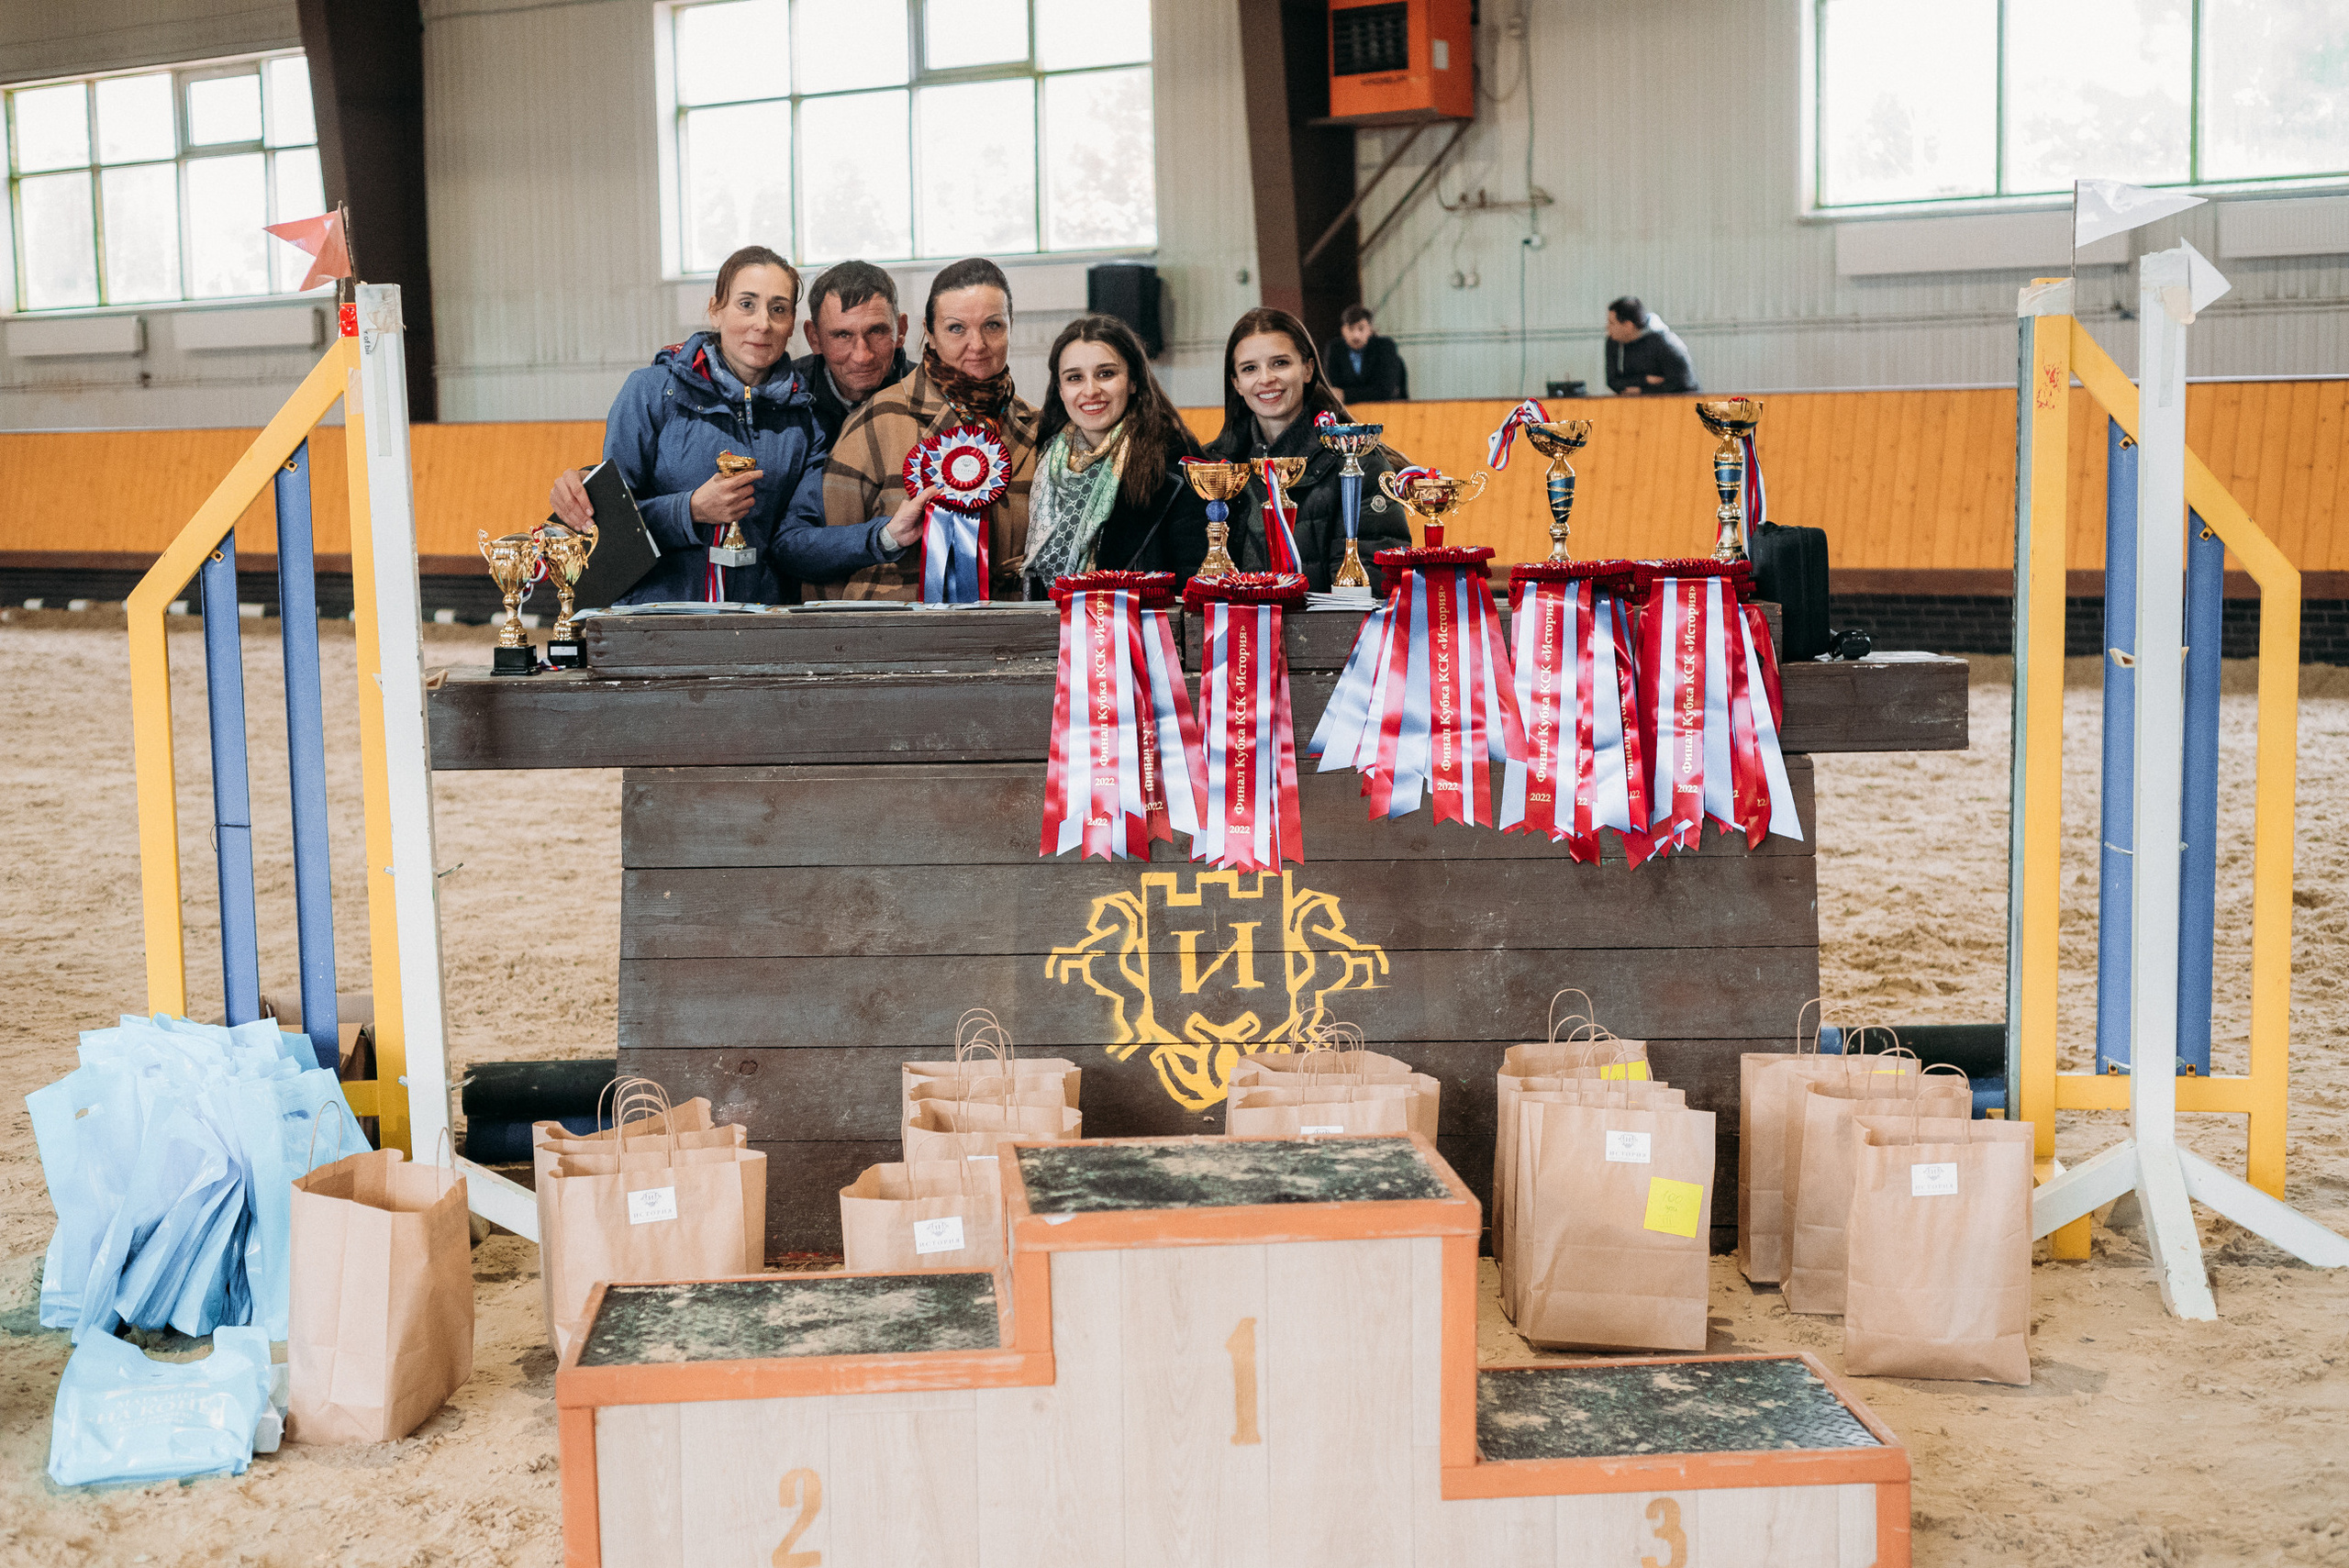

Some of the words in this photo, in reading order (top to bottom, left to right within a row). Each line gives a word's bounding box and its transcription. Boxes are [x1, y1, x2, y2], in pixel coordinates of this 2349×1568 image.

[1095, 589, 1108, 645] «Истори
[1437, 584, 1450, 651] «История»
[1542, 593, 1556, 662] «История»
[1685, 585, 1699, 652] «История»
[1095, 648, 1107, 678] КСК
[1236, 625, 1250, 693] «История»
[1438, 652, 1450, 683] КСК
[1540, 663, 1552, 695] КСК
[1684, 654, 1696, 684] КСК
[1097, 680, 1110, 720] Кубка
[1235, 695, 1246, 726] КСК
[1440, 685, 1453, 725] Кубка
[1538, 697, 1552, 737] Кубка
[1683, 687, 1696, 727] Кубка
[1098, 723, 1108, 766] Финал
[1235, 728, 1249, 768] Кубка
[1441, 728, 1452, 772] Финал
[1535, 739, 1549, 783] Финал
[1682, 729, 1693, 773] Финал
[1095, 777, 1115, 786] 2022
[1234, 771, 1245, 815] Финал
[1437, 782, 1458, 791] 2022
[1530, 793, 1552, 802] 2022
[1576, 797, 1588, 806] 22
[1677, 784, 1698, 794] 2022
[1229, 825, 1251, 834] 2022
[633, 1208, 673, 1218] ИСТОРИЯ
[1225, 1317, 1262, 1446] 1
[772, 1467, 822, 1568] 2
[1641, 1496, 1687, 1568] 3
